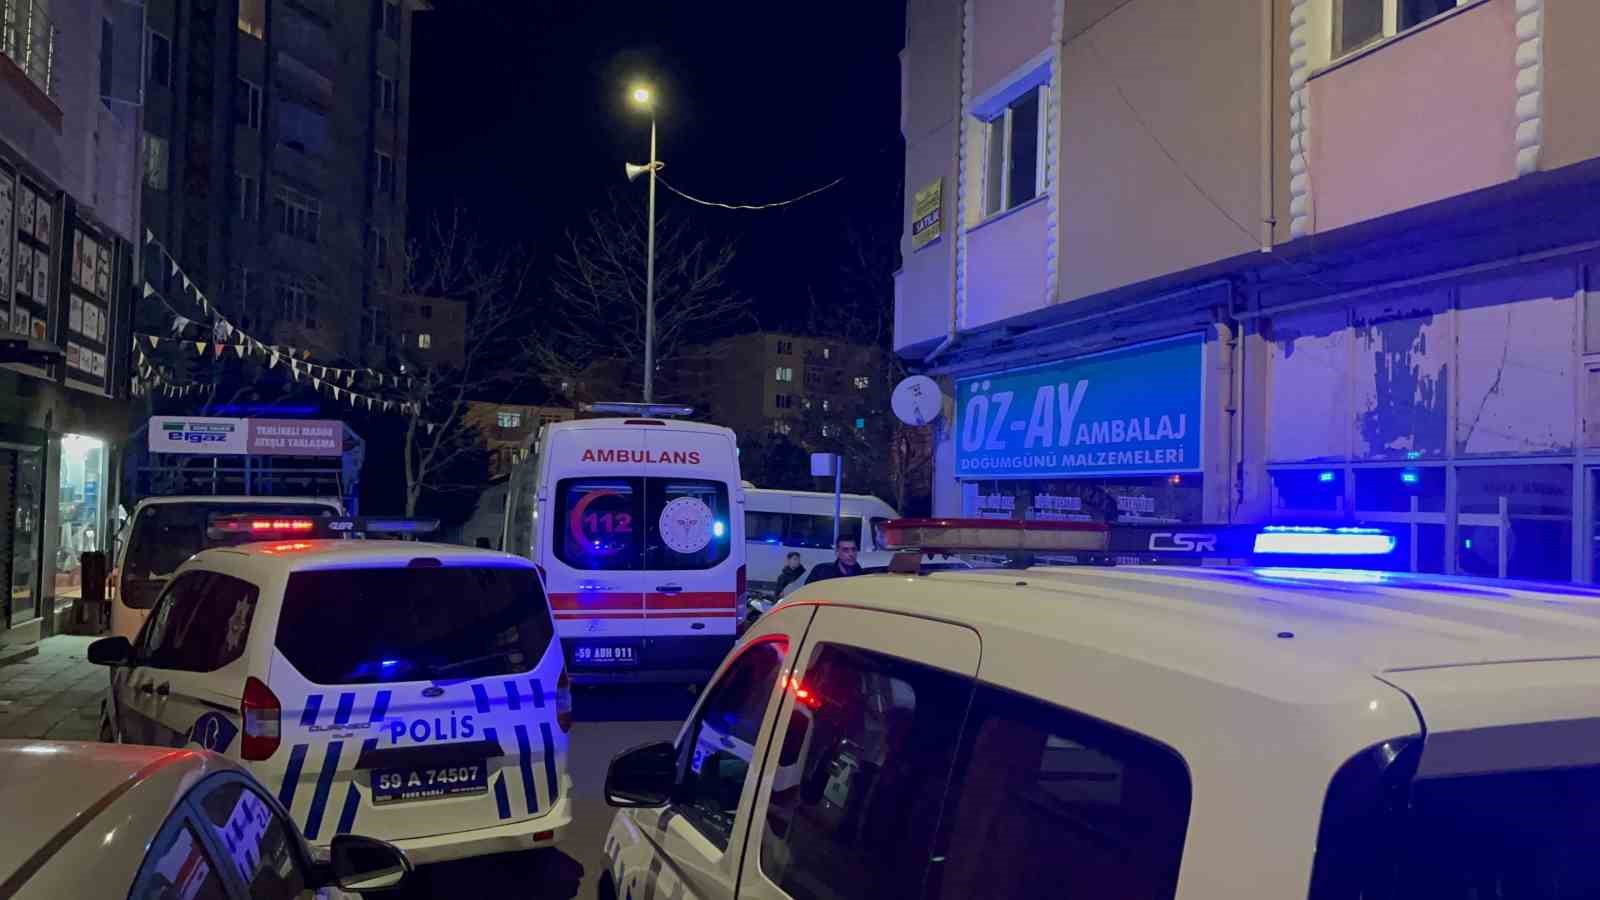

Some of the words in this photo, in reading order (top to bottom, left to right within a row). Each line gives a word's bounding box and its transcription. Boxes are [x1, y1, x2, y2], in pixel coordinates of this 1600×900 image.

[962, 379, 1089, 452] ÖZ-AY
[1075, 413, 1187, 446] AMBALAJ
[581, 449, 701, 465] AMBULANS
[1062, 444, 1184, 467] MALZEMELERİ
[583, 512, 633, 533] 112
[1149, 532, 1217, 553] CSR
[390, 711, 475, 745] POLİS
[379, 774, 401, 790] 59
[407, 771, 421, 787] A
[426, 766, 479, 786] 74507
